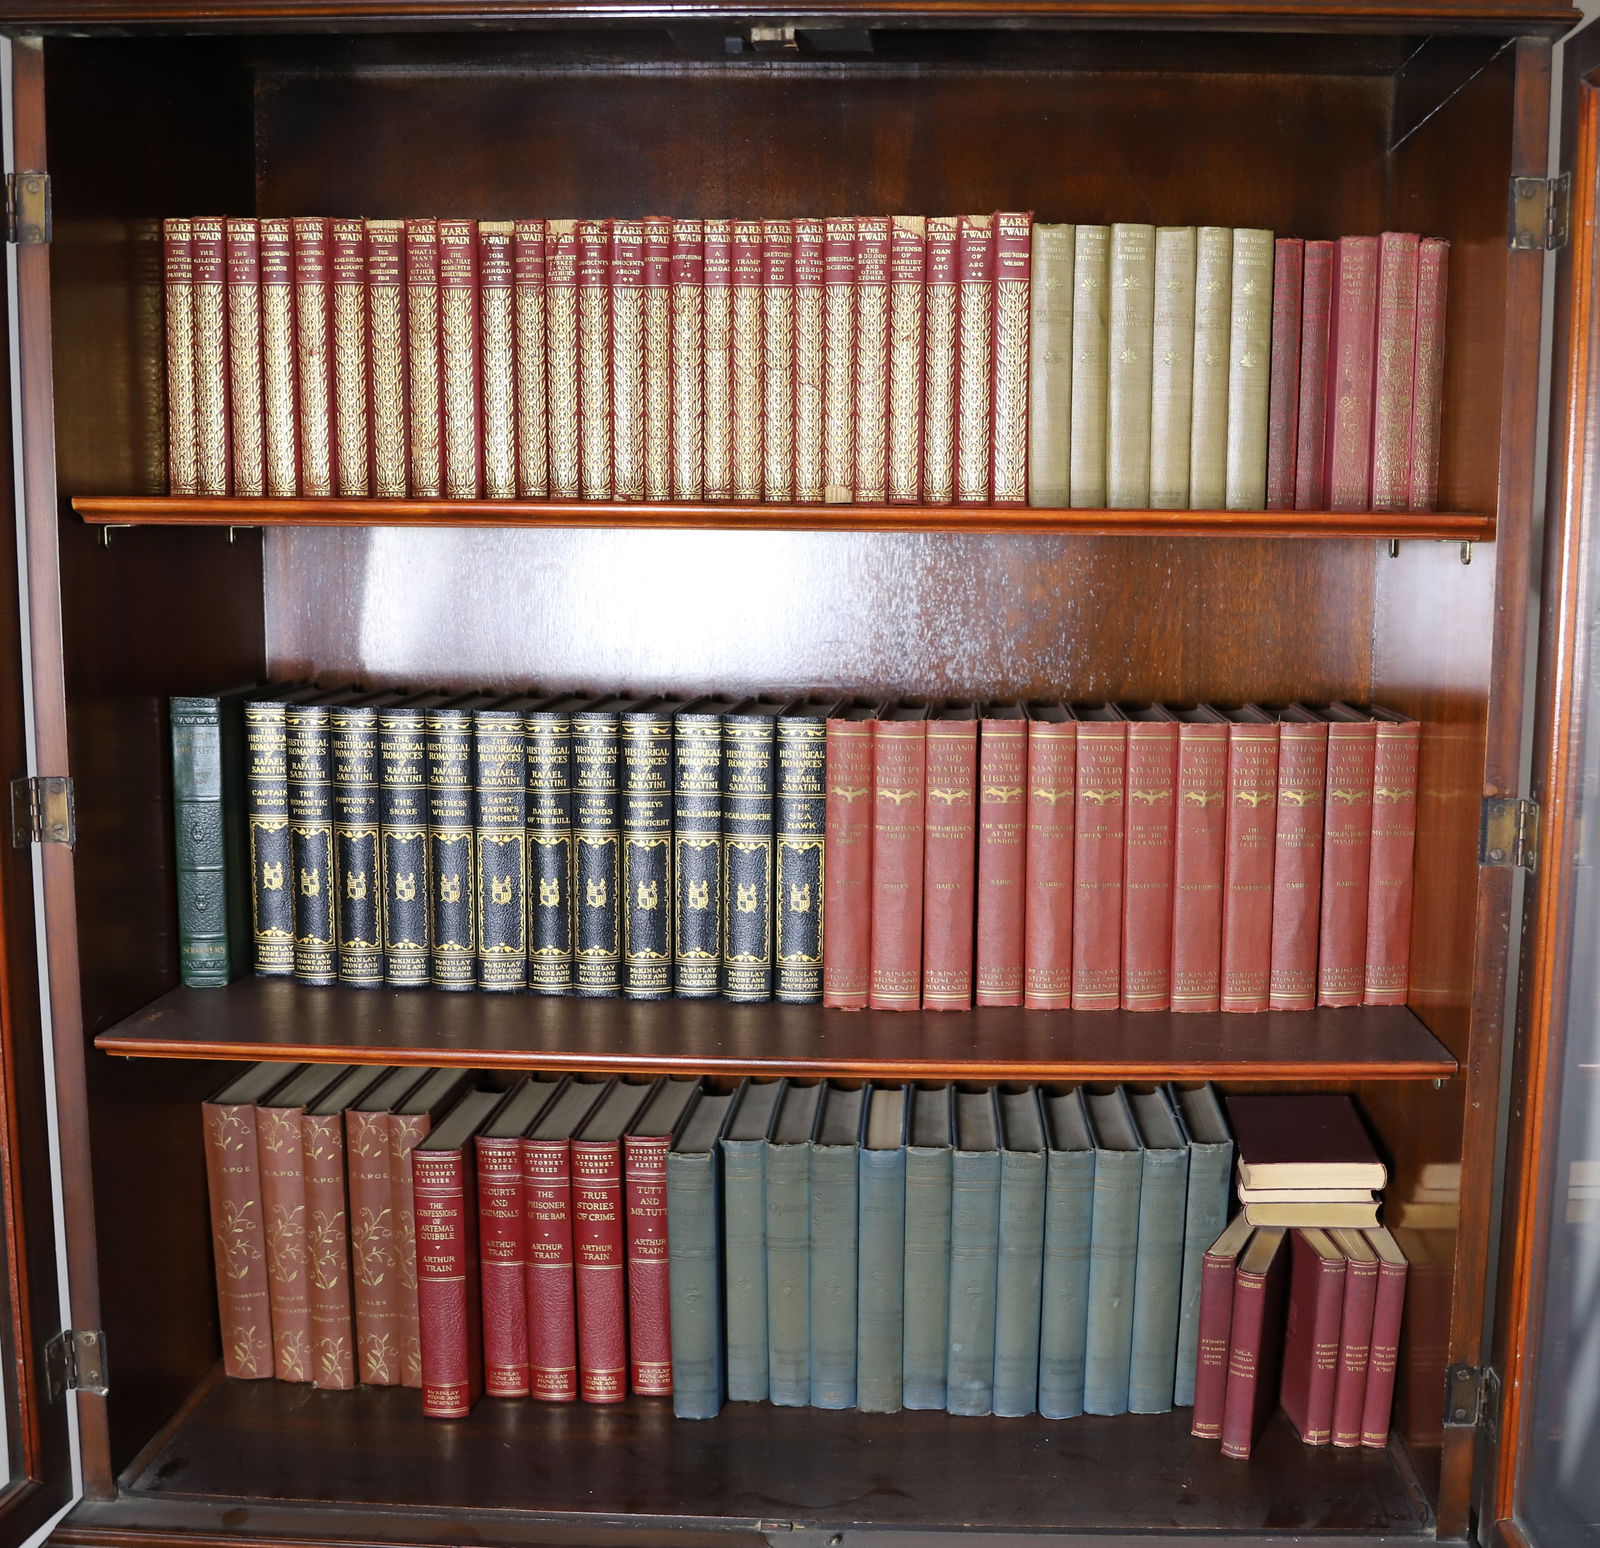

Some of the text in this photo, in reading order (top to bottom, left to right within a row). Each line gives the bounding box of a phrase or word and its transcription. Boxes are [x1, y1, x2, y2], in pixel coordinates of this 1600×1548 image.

[999, 218, 1029, 227] MARK
[193, 223, 222, 232] MARK
[261, 224, 289, 233] MARK
[408, 225, 435, 234] MARK
[441, 227, 469, 236] MARK
[614, 225, 643, 235] MARK
[826, 223, 854, 232] MARK
[999, 228, 1029, 236] TWAIN
[193, 232, 222, 241] TWAIN
[260, 234, 289, 242] TWAIN
[408, 234, 436, 243] TWAIN
[441, 236, 470, 245] TWAIN
[613, 235, 643, 244] TWAIN
[826, 232, 855, 241] TWAIN
[928, 232, 956, 241] TWAIN
[333, 741, 376, 749] HISTORICAL
[381, 743, 425, 751] HISTORICAL
[928, 744, 973, 752] SCOTLAND
[288, 748, 326, 756] ROMANCES
[624, 748, 670, 756] HISTORICAL
[254, 758, 285, 766] RAFAEL
[938, 754, 962, 763] YARD
[1091, 755, 1115, 763] YARD
[289, 771, 325, 779] SABATINI
[384, 775, 422, 783] SABATINI
[927, 776, 970, 784] LIBRARY
[1080, 776, 1122, 785] LIBRARY
[627, 781, 666, 789] SABATINI
[629, 800, 663, 808] BARDELYS
[481, 806, 520, 814] MARTIN'S
[676, 810, 721, 818] BELLARION
[724, 812, 771, 820] SCARAMOUCHE
[637, 1186, 663, 1194] TUTT
[582, 1192, 608, 1200] TRUE
[577, 1202, 614, 1210] STORIES
[417, 1209, 458, 1217] CONFESSIONS
[481, 1209, 519, 1218] CRIMINALS
